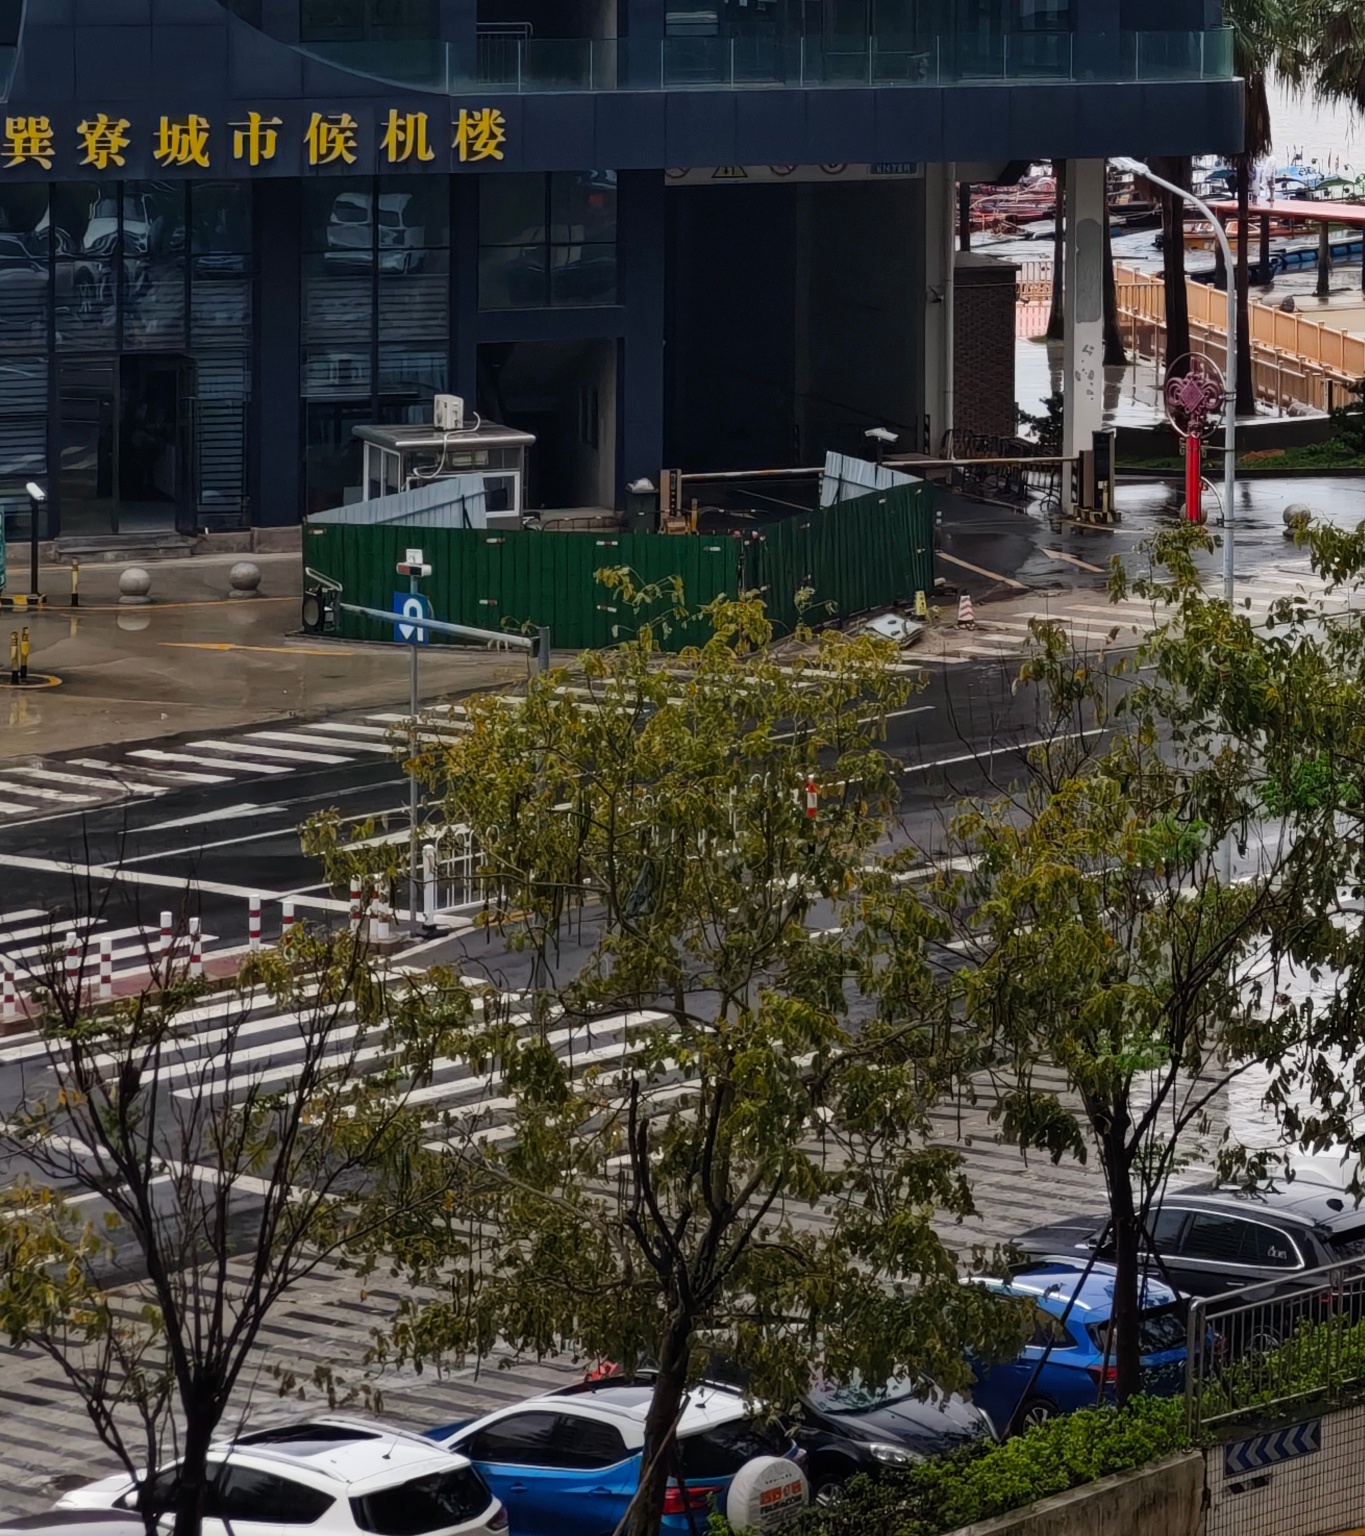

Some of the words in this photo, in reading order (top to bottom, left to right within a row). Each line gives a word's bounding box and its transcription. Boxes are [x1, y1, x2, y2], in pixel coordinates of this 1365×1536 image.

[1, 108, 507, 171] 巽寮城市候机楼
